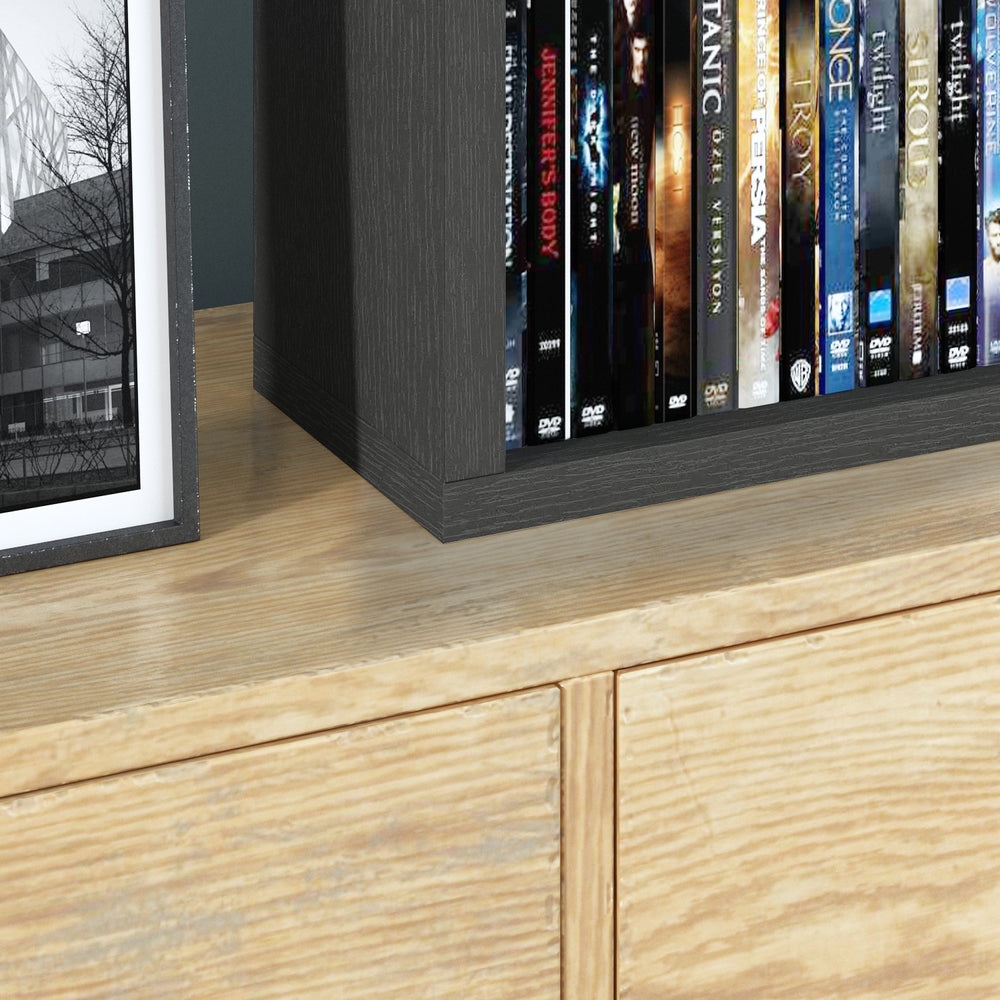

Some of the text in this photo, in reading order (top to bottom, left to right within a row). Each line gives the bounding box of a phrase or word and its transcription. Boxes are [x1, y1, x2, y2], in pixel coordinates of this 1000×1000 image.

[589, 34, 598, 75] THE
[945, 19, 972, 122] twilight
[757, 73, 768, 108] OF
[867, 31, 894, 133] twilight
[540, 48, 559, 258] JENNIFER'S BODY
[791, 70, 814, 185] TROY
[589, 161, 598, 241] KNIGHT
[630, 164, 640, 225] moon
[751, 108, 767, 245] PERSIA
[870, 337, 892, 348] DVD
[949, 345, 970, 358] DVD
[538, 416, 561, 429] DVD
[582, 404, 605, 417] DVD
[669, 394, 688, 406] DVD
